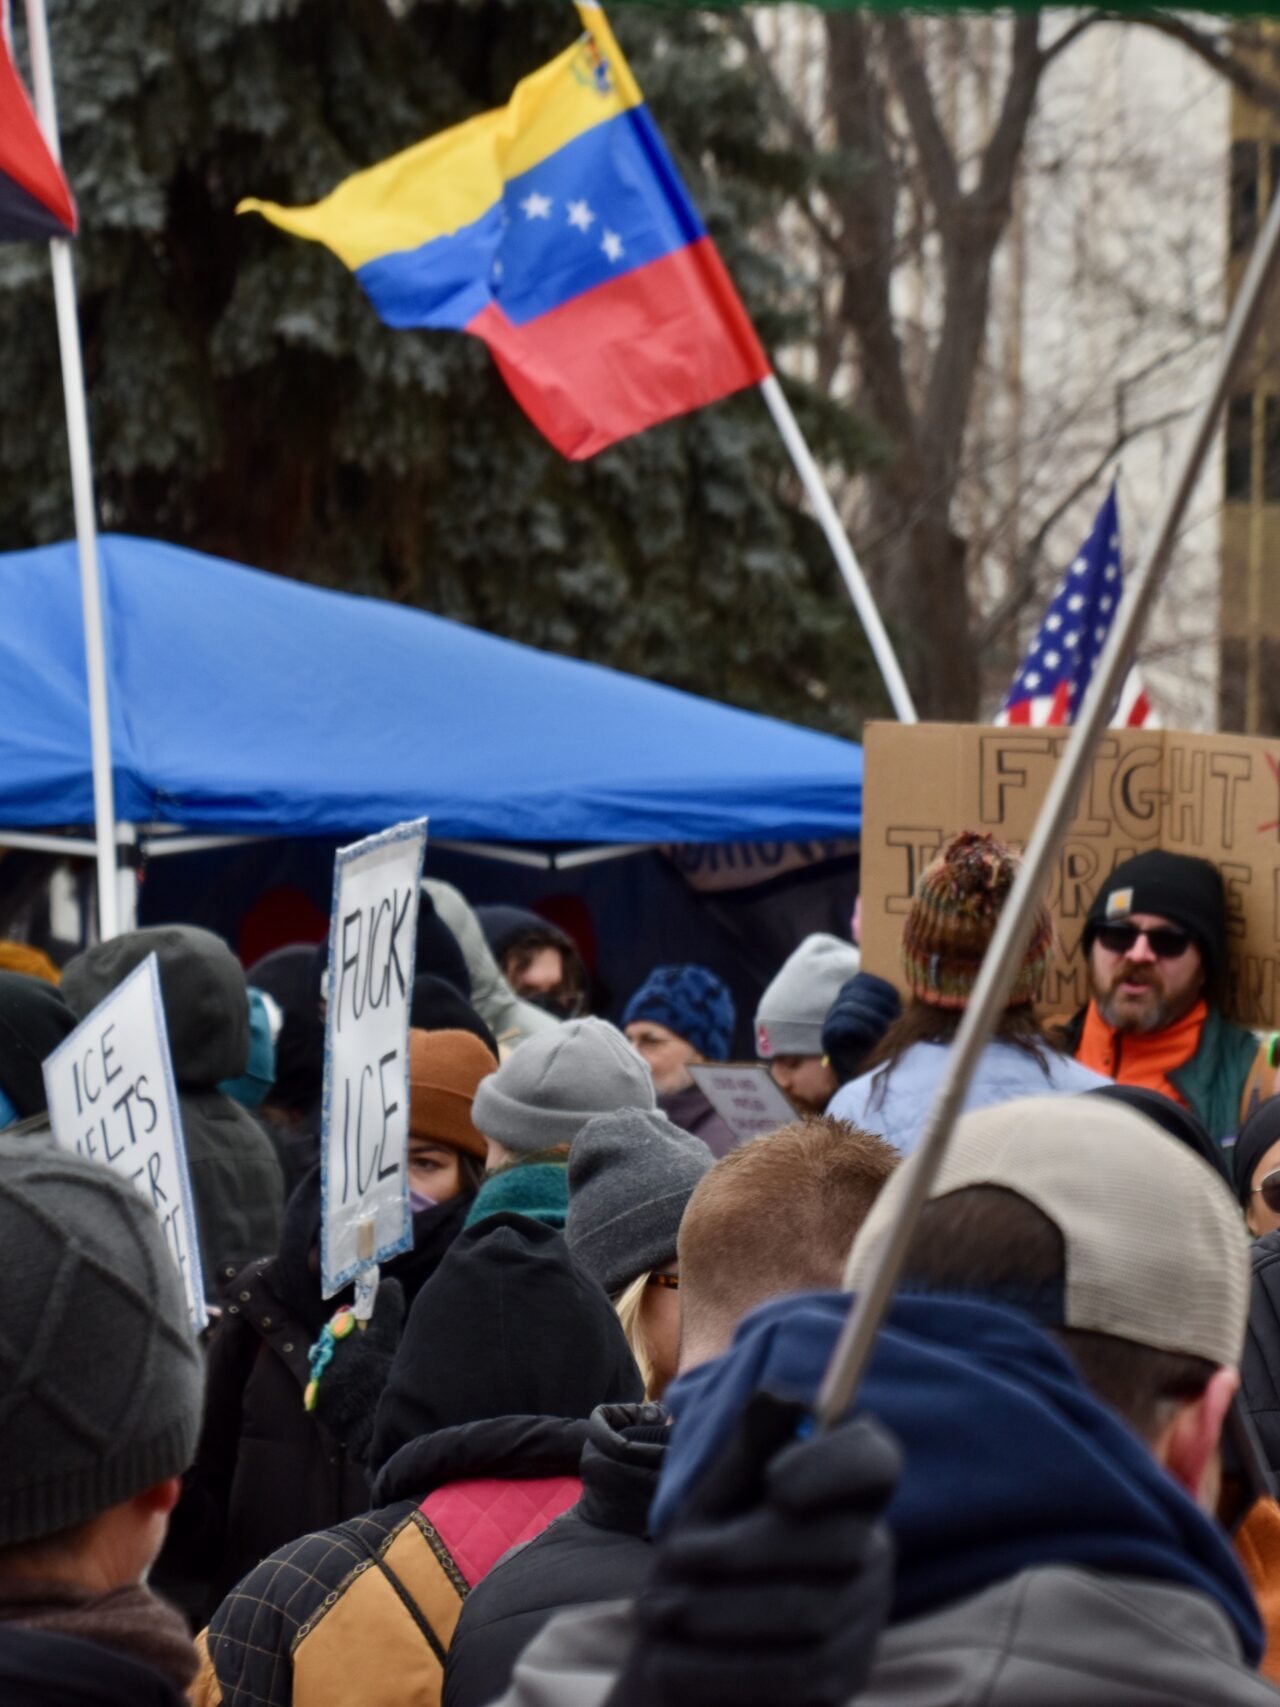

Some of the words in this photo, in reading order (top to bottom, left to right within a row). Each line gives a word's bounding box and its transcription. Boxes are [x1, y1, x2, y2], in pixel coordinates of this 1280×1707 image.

[979, 735, 1252, 849] FIGHT
[337, 887, 412, 1033] FUCK
[72, 1022, 123, 1116] ICE
[76, 1075, 158, 1163] ELTS
[341, 1049, 400, 1205] ICE
